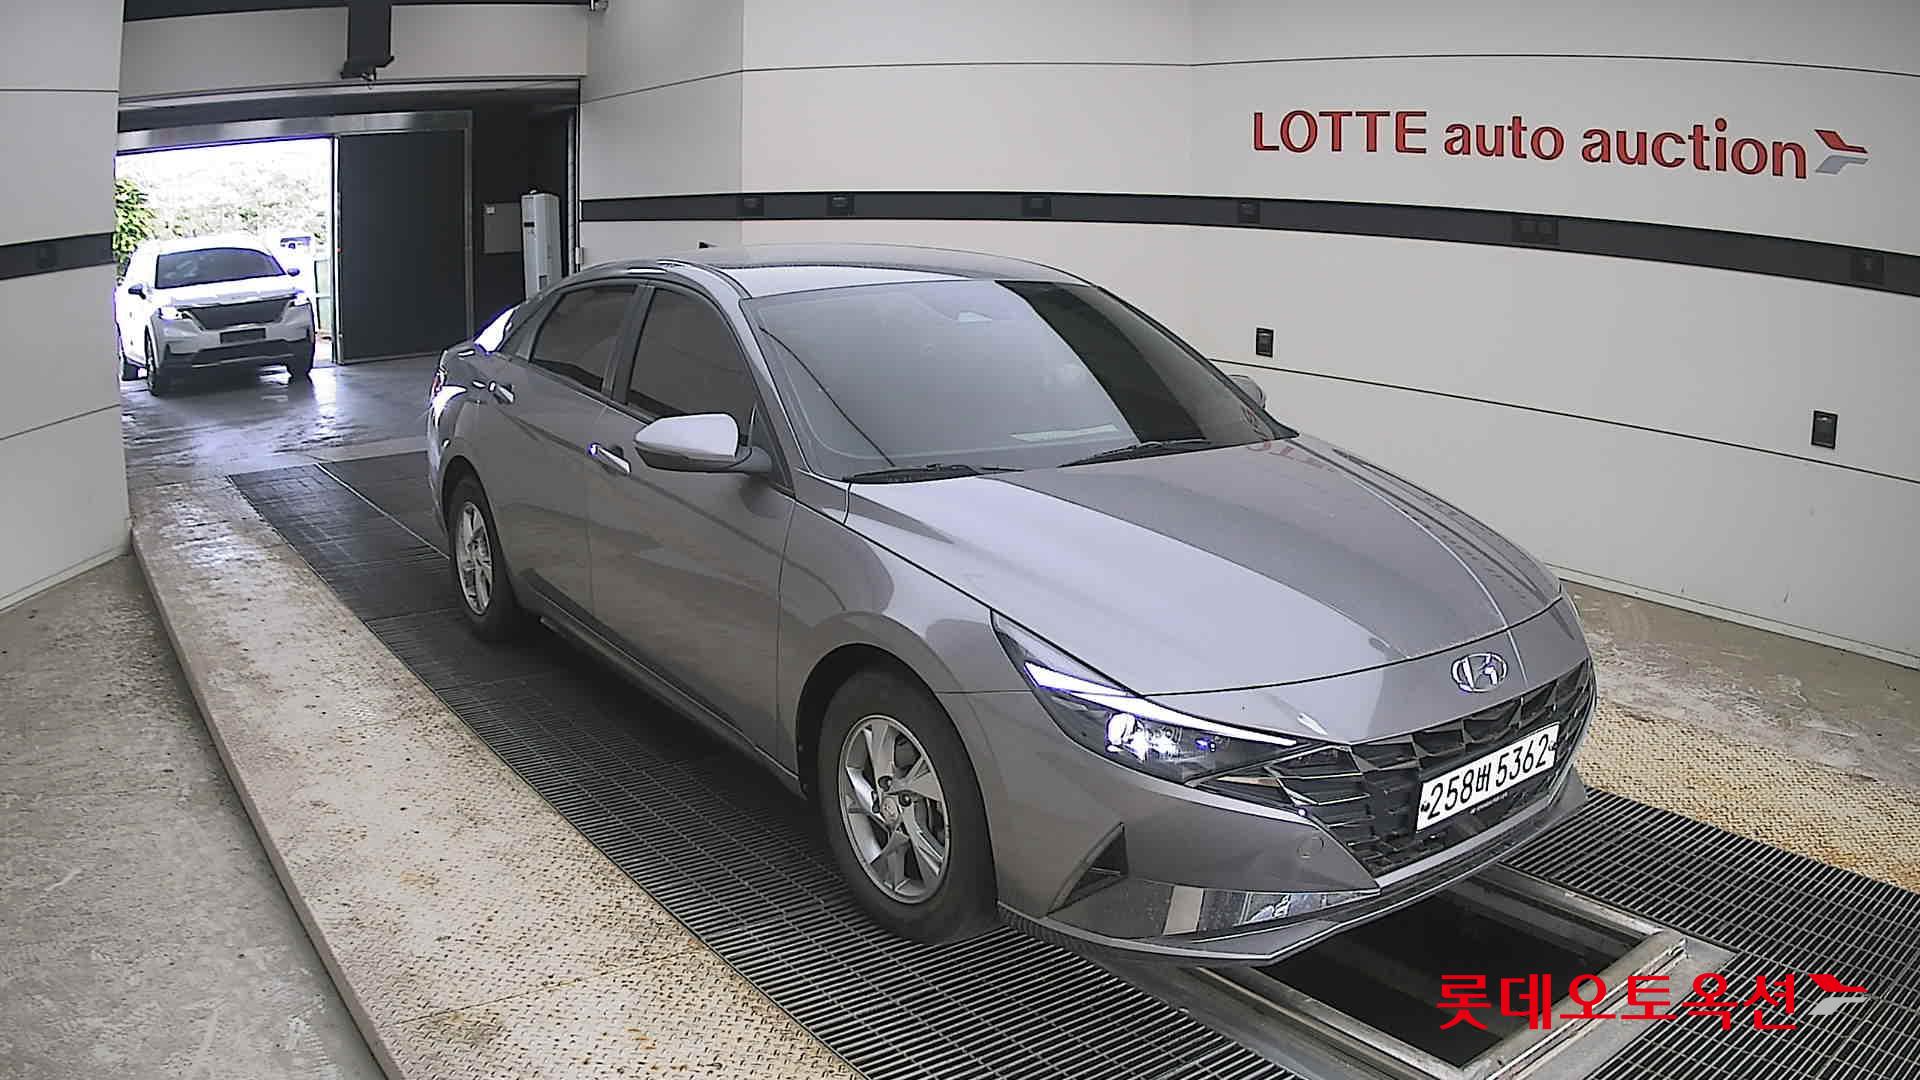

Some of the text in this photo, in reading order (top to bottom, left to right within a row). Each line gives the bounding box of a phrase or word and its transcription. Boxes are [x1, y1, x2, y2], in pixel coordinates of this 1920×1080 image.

[1253, 110, 1807, 179] LOTTE auto auction
[1428, 733, 1549, 820] 258버 5362
